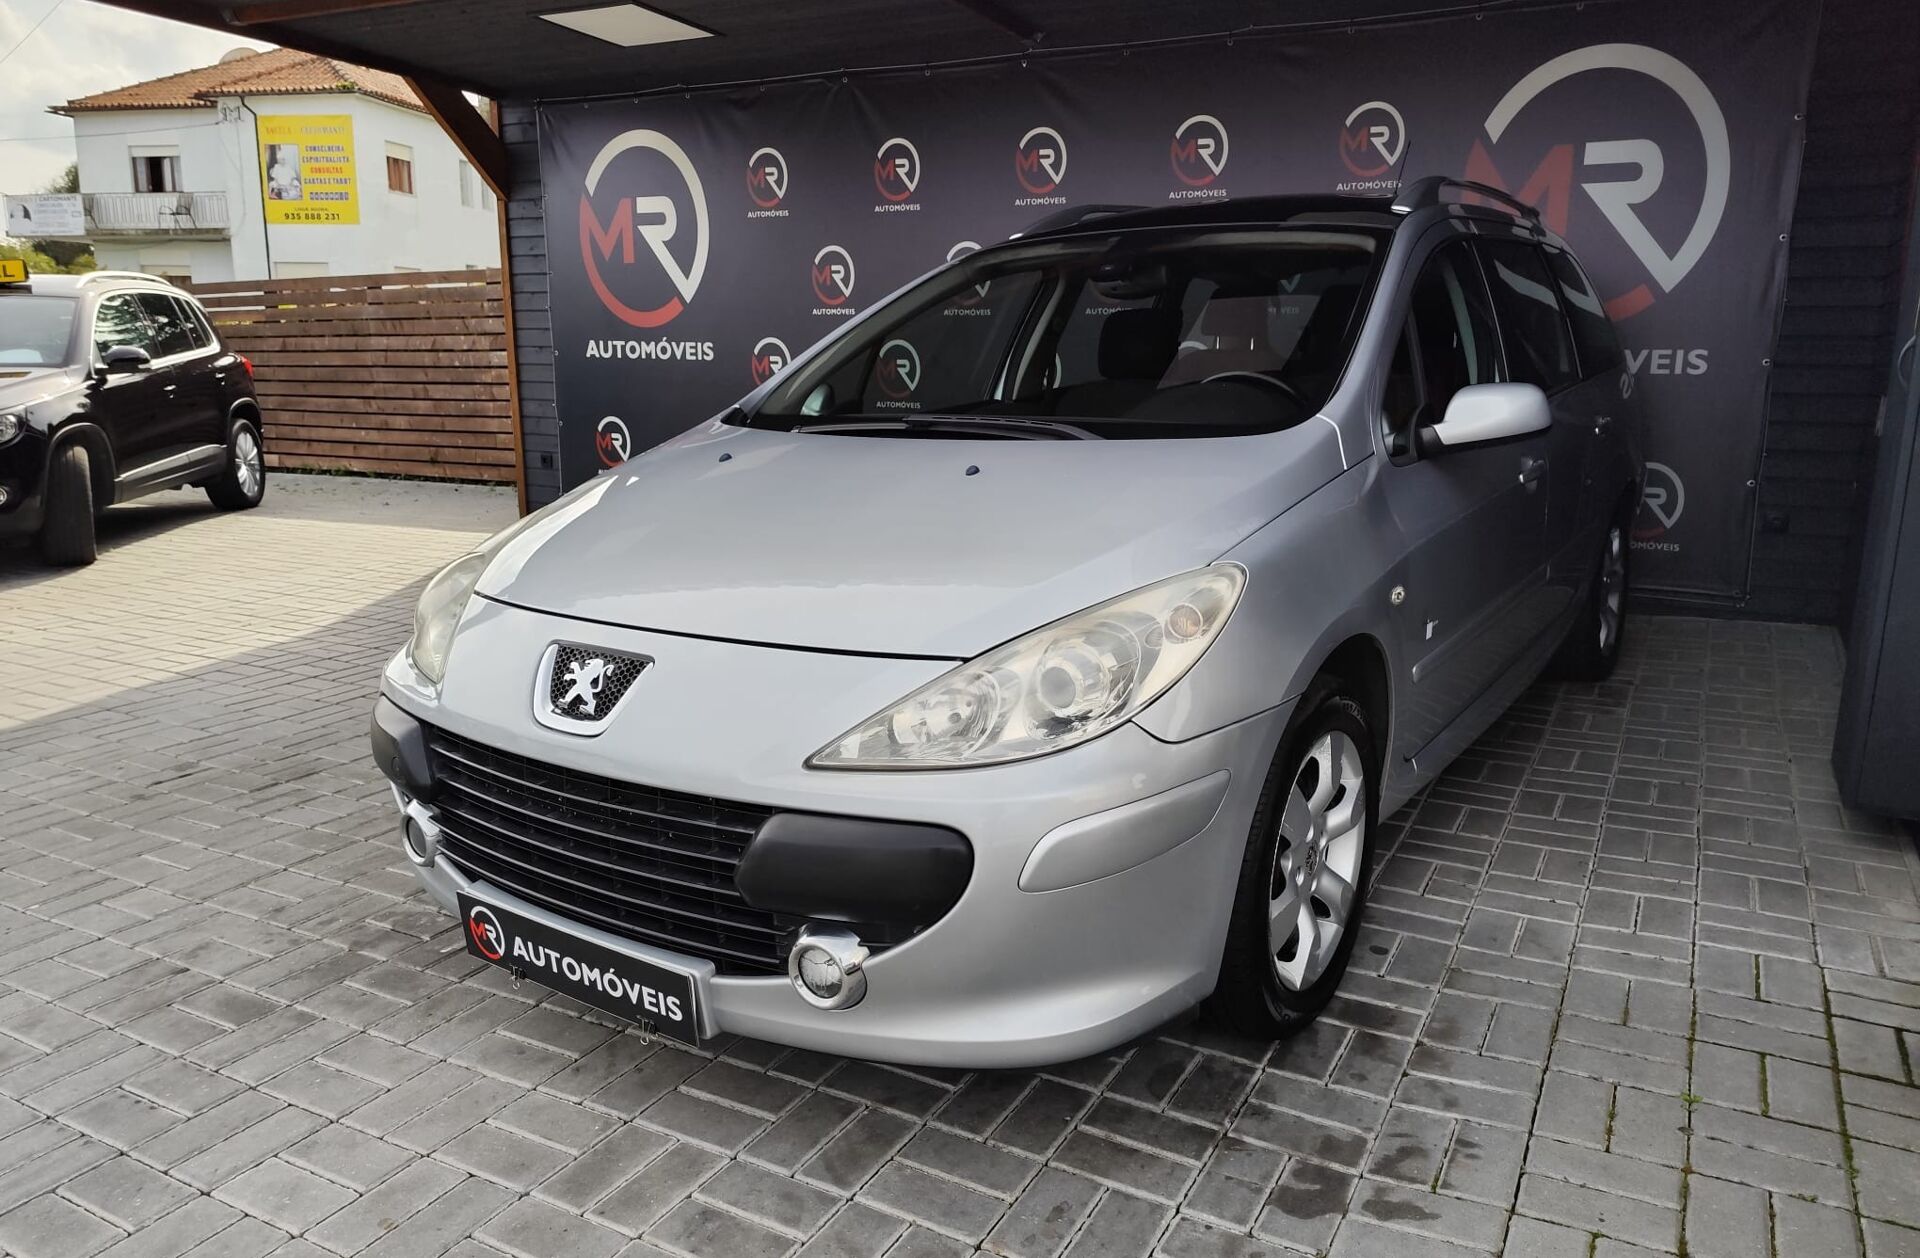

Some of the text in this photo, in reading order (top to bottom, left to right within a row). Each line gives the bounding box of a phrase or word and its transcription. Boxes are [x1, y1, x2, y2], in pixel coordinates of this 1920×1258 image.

[1169, 189, 1227, 200] AUTOMÓVEIS
[1015, 197, 1066, 206] AUTOMÓVEIS
[874, 203, 921, 212] AUTOMÓVEIS
[747, 210, 789, 218] AUTOMÓVEIS
[812, 308, 856, 316] AUTOMÓVEIS
[944, 307, 991, 316] AUTOMÓVEIS
[586, 337, 714, 361] AUTOMÓVEIS
[876, 400, 921, 409] AUTOMÓVEIS
[513, 936, 683, 1021] AUTOMÓVEIS
